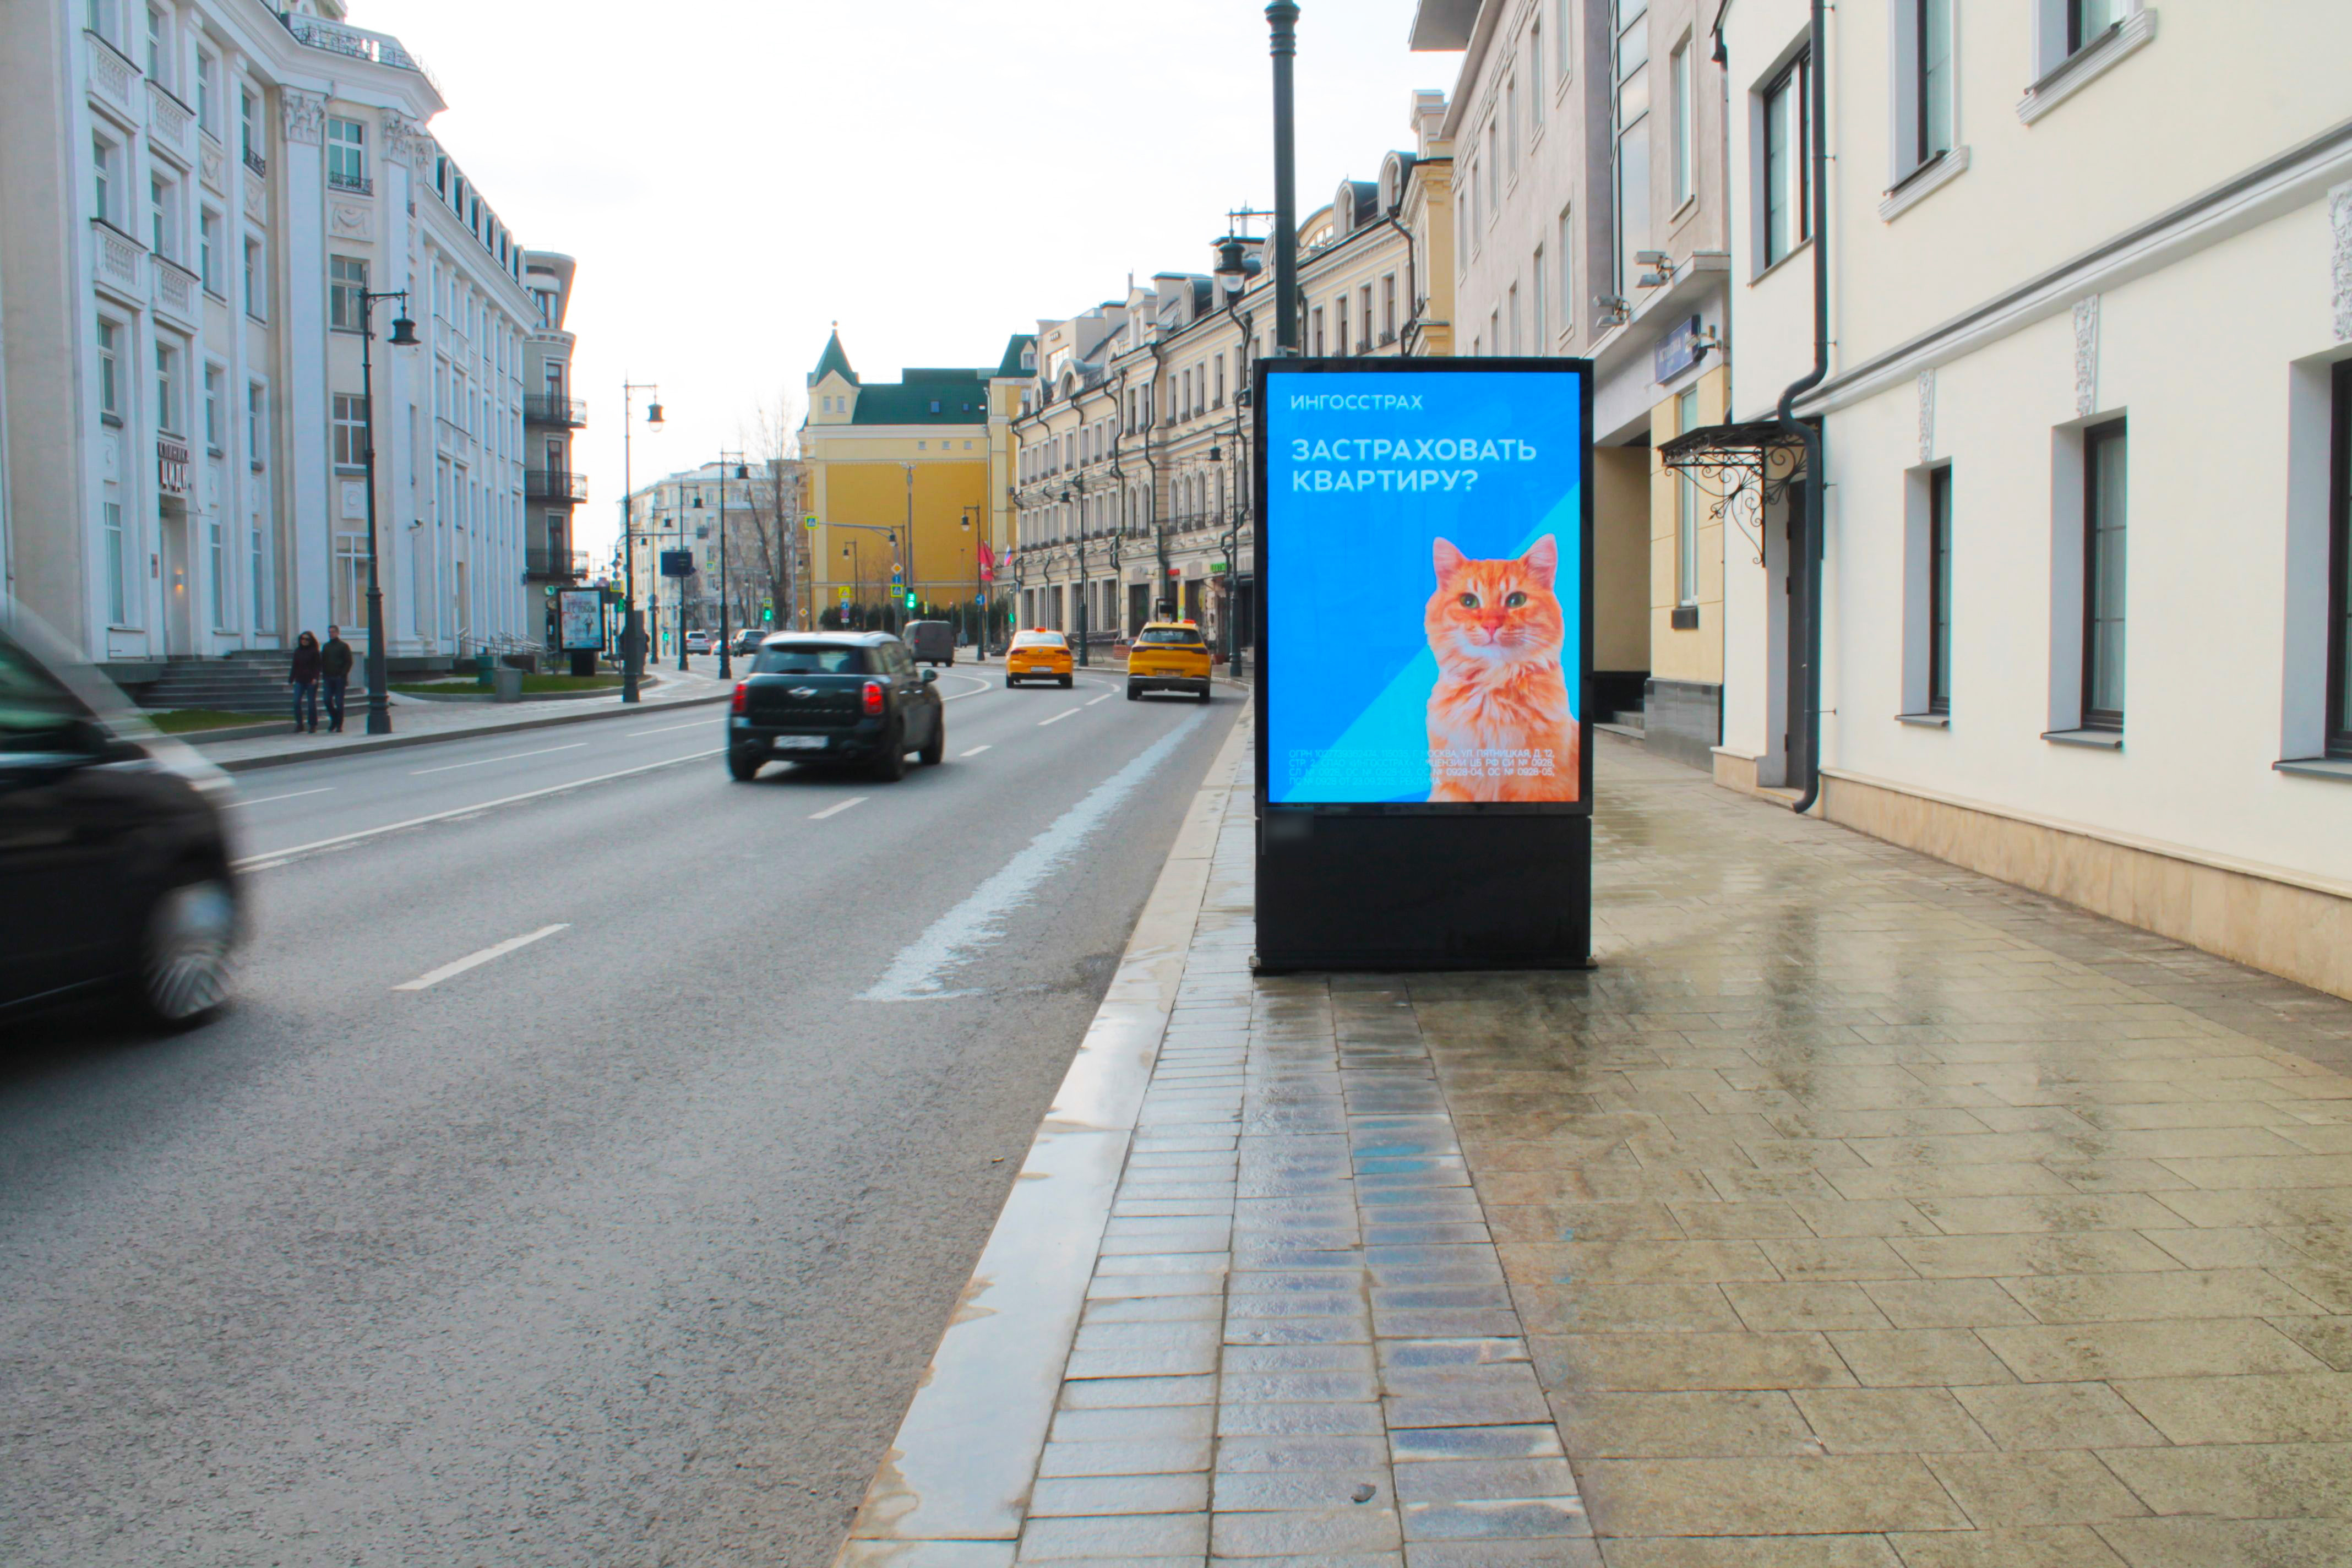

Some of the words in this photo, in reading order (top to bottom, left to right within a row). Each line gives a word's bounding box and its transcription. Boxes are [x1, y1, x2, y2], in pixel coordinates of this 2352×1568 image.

[1291, 395, 1423, 410] ИНГОССТРАХ
[1292, 439, 1537, 461] ЗАСТРАХОВАТЬ
[1293, 469, 1478, 492] КВАРТИРУ?
[1289, 749, 1313, 758] ОГРН
[1477, 749, 1531, 759] ПЯТНИЦКАЯ,
[1486, 759, 1499, 767] РФ
[1502, 759, 1514, 767] СИ
[1488, 768, 1501, 776] ОС
